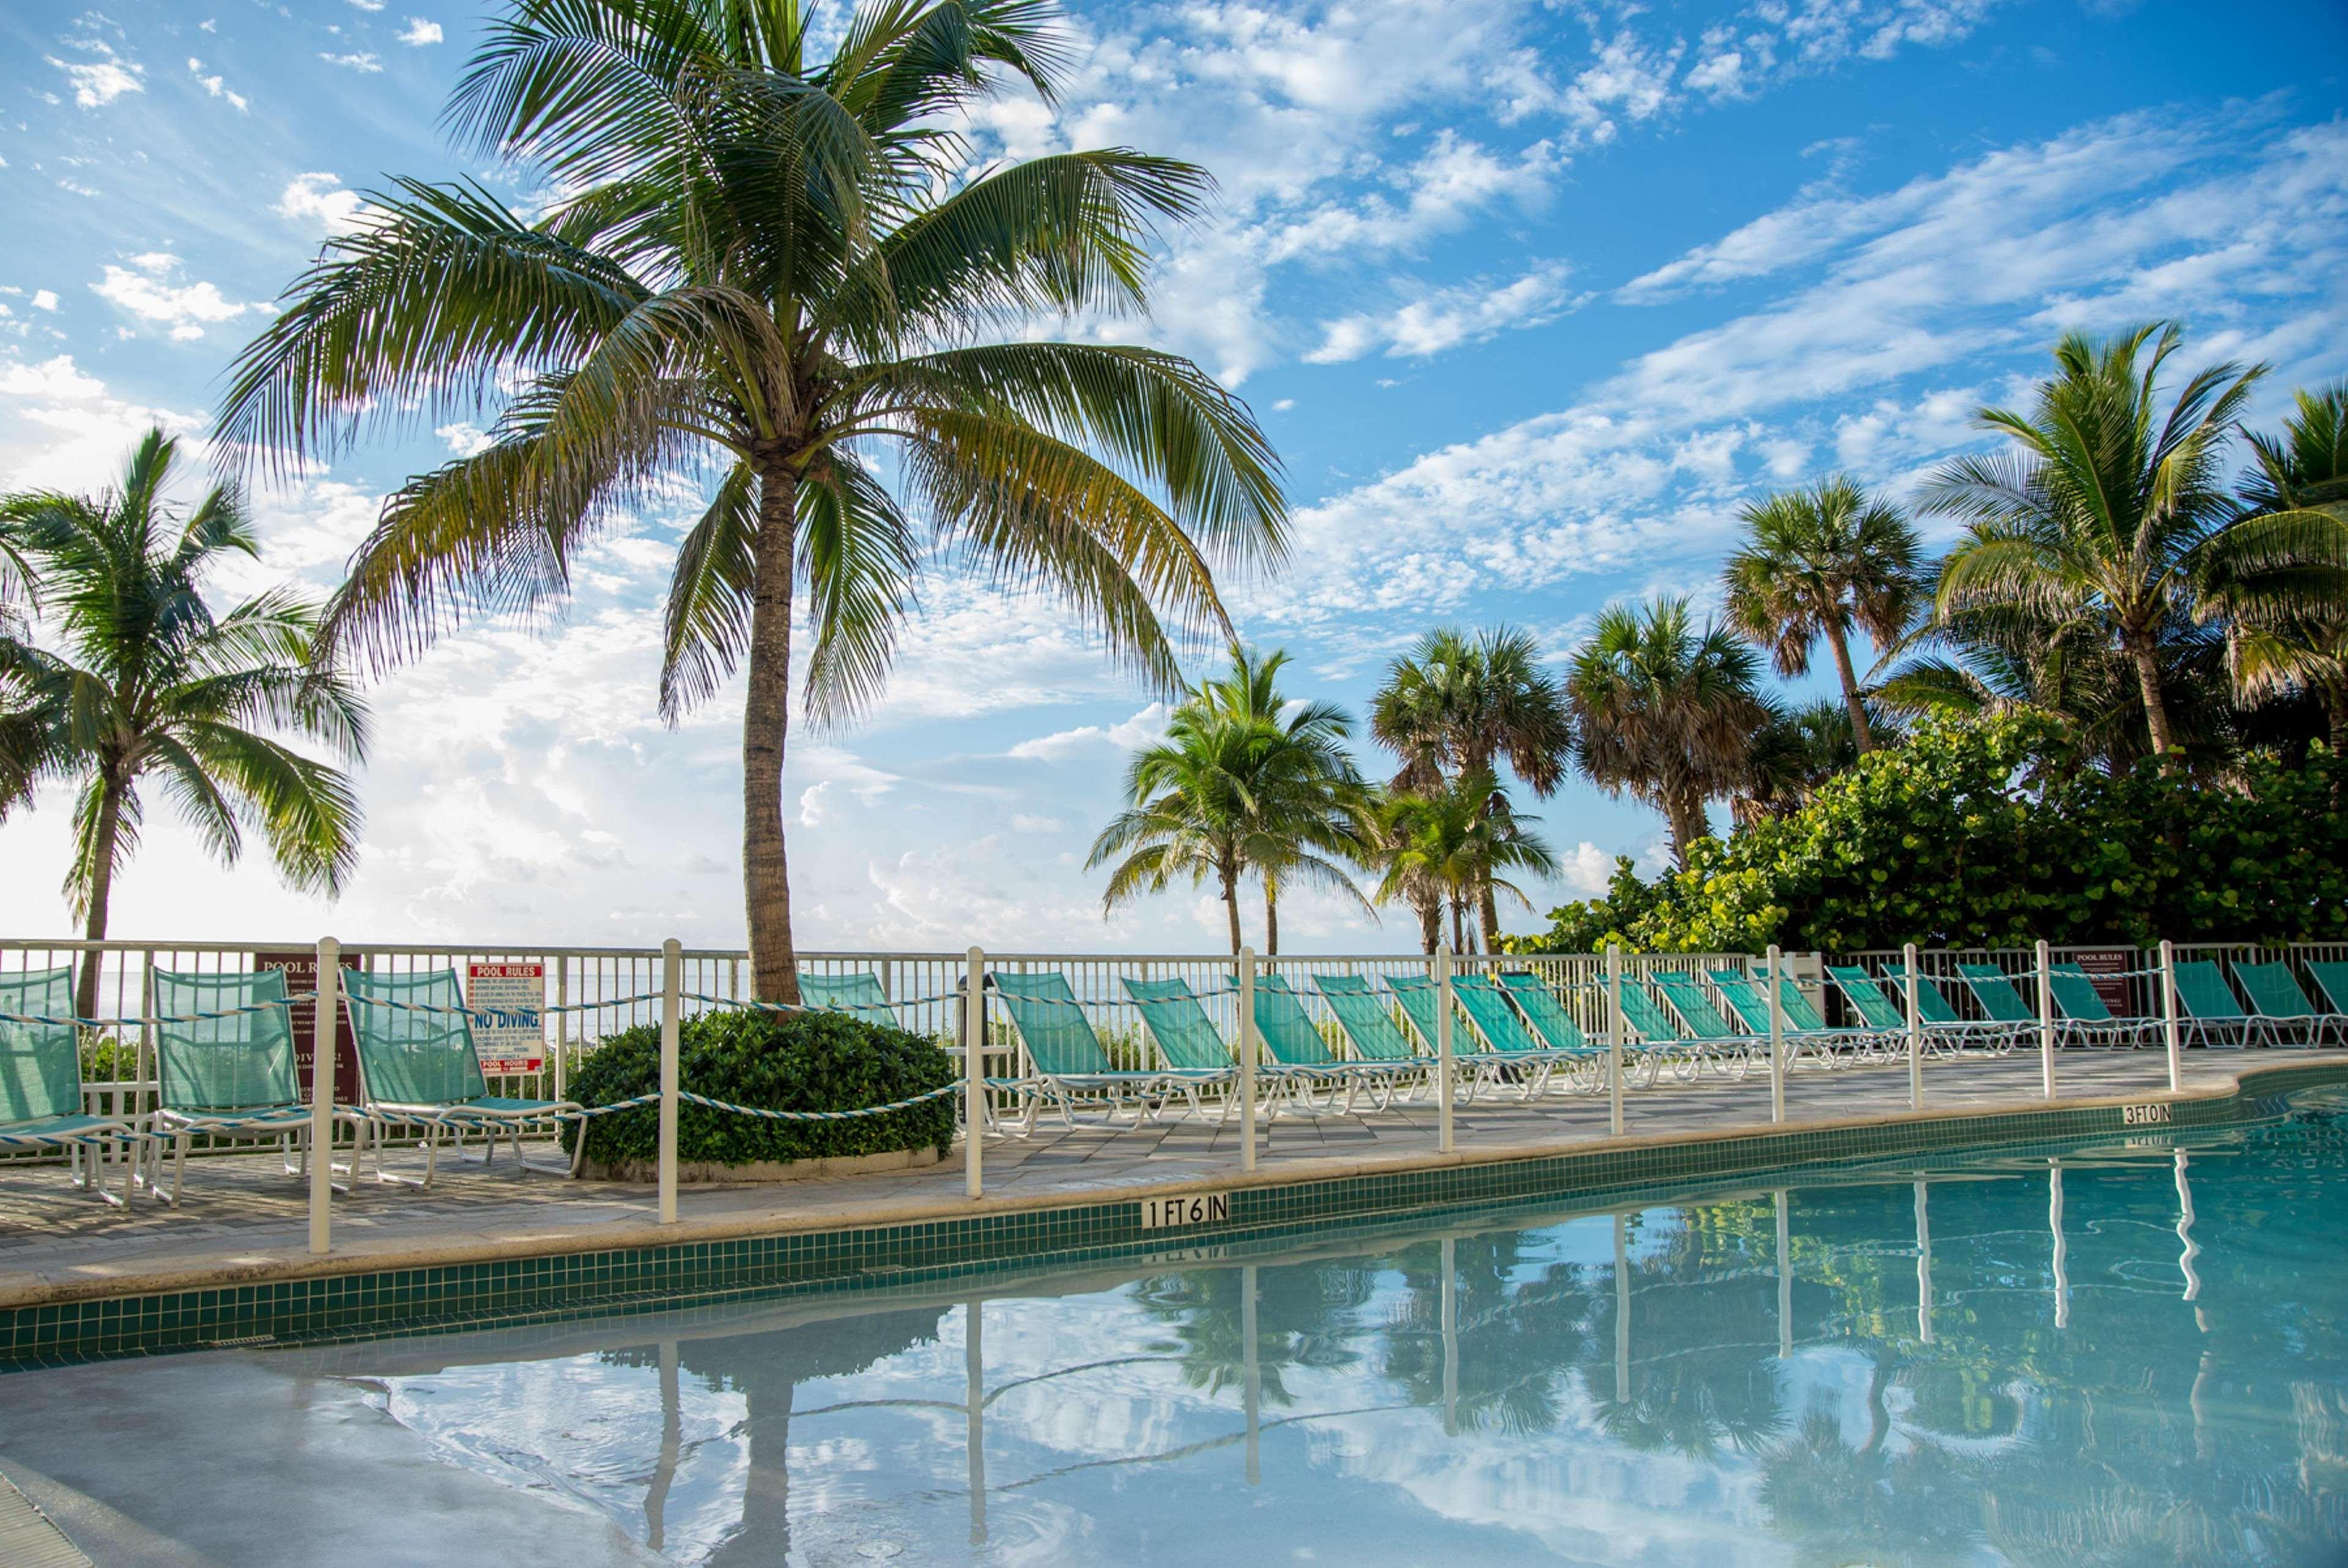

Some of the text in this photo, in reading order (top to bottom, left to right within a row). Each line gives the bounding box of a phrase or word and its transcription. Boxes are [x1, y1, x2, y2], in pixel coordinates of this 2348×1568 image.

[478, 967, 535, 976] POOL RULES
[475, 1013, 541, 1028] NO DIVING.
[1150, 1194, 1227, 1227] 1 FT 6 IN
